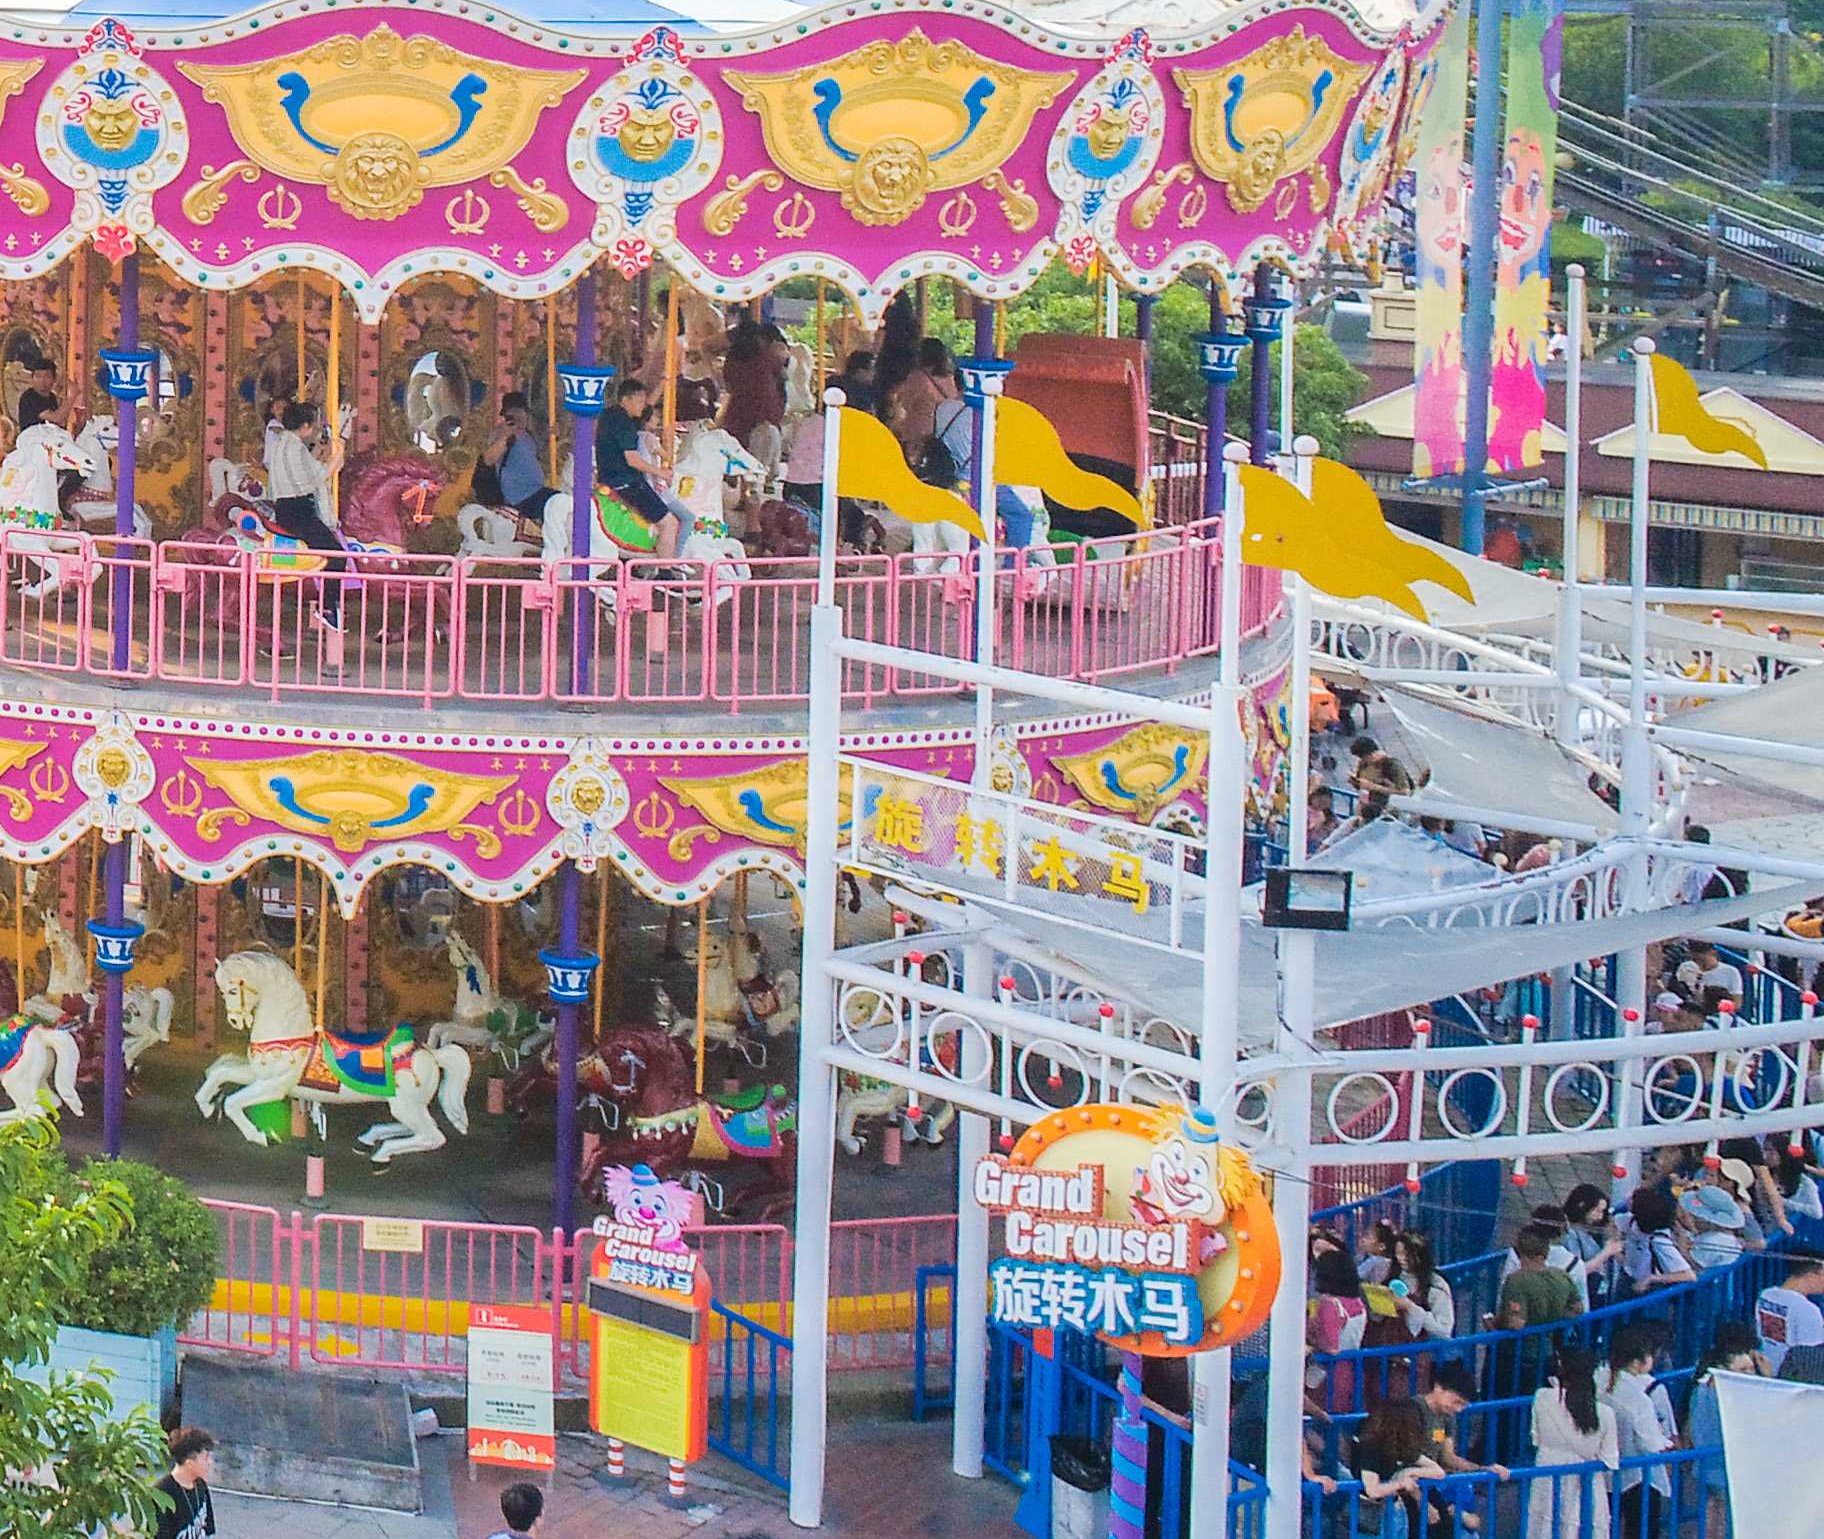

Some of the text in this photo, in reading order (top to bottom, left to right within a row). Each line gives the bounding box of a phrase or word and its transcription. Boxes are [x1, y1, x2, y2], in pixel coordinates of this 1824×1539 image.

[873, 793, 1152, 916] 旋转木马
[974, 1160, 1094, 1213] Grand
[593, 1215, 655, 1245] Grand
[605, 1238, 697, 1272] Carousel
[1005, 1211, 1188, 1269] Carousel
[609, 1260, 694, 1295] 旋转木马
[991, 1266, 1189, 1341] 旋转木马
